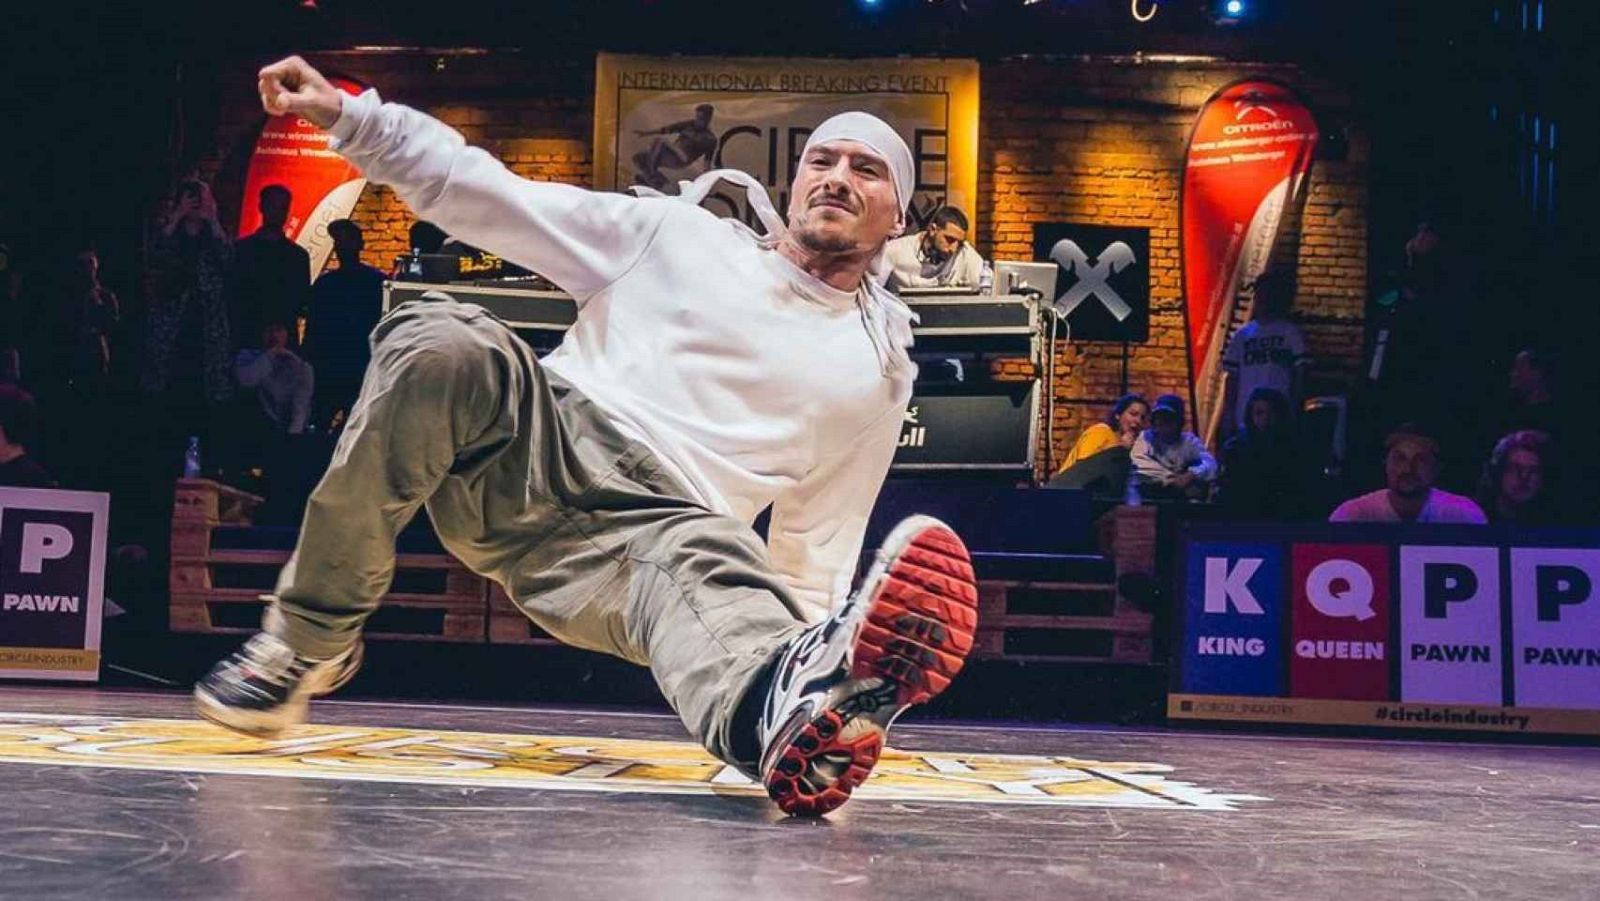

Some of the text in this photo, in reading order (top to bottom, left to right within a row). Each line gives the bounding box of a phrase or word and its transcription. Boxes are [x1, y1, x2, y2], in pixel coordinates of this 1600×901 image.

[617, 71, 950, 94] INTERNATIONAL BREAKING EVENT
[20, 522, 74, 574] P
[1204, 557, 1265, 615] K
[1306, 559, 1376, 621] Q
[1424, 562, 1479, 619] P
[1537, 565, 1592, 622] P
[3, 593, 80, 613] PAWN
[1198, 636, 1265, 656] KING
[1296, 639, 1384, 660] QUEEN
[1410, 643, 1491, 663] PAWN
[1524, 646, 1600, 667] PAWN
[1375, 707, 1530, 730] #circleindustry
